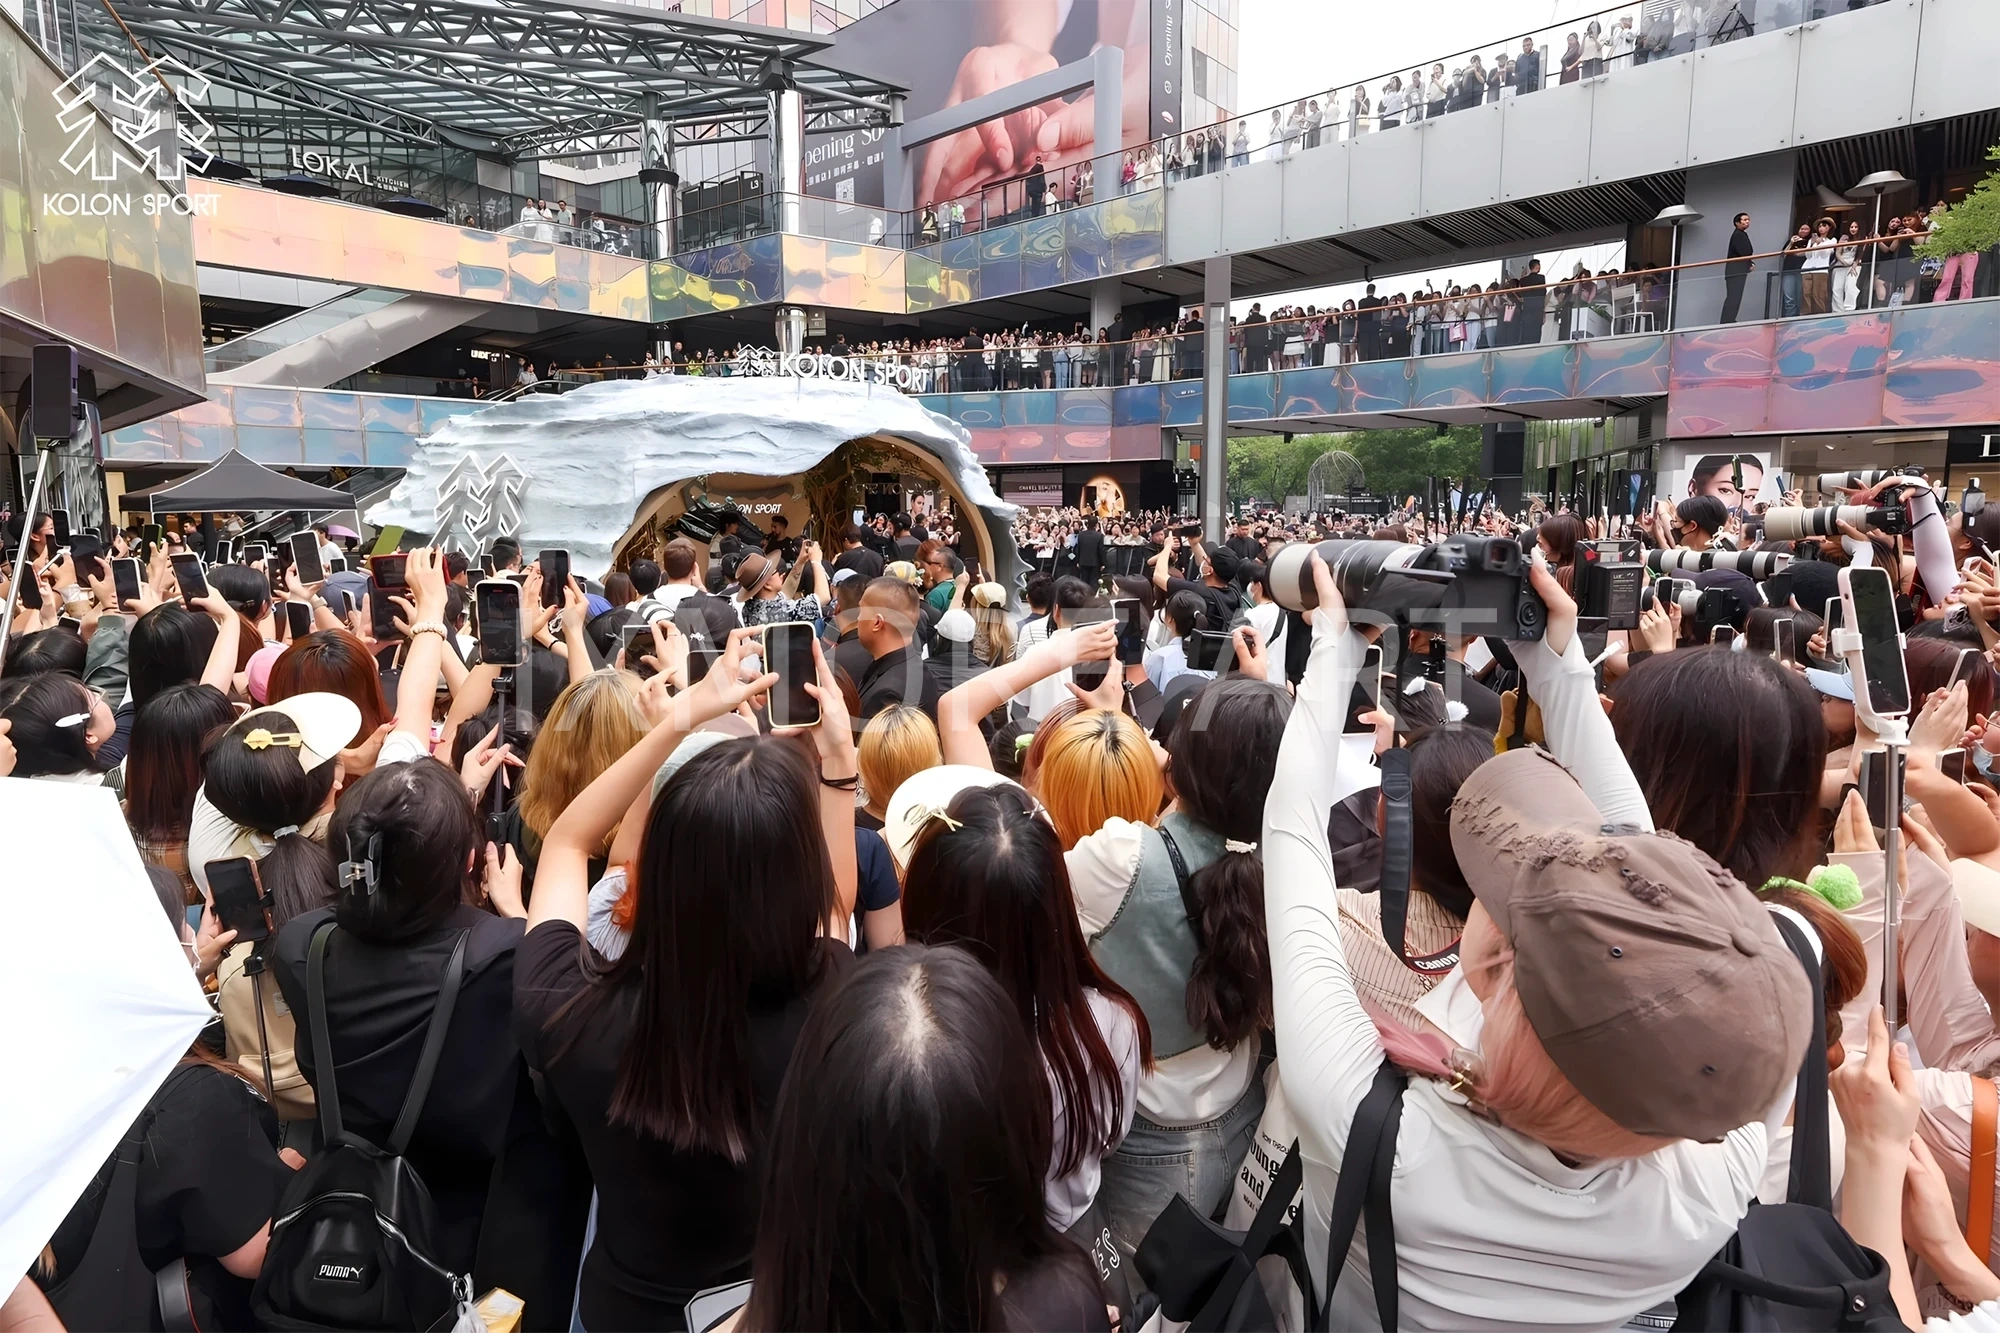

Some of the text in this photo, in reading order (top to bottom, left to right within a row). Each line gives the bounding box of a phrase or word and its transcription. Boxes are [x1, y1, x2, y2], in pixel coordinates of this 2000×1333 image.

[292, 146, 374, 186] LOKAL
[805, 133, 855, 167] pening
[779, 351, 930, 393] KOLON SPORT
[754, 503, 782, 514] SPORT
[1414, 952, 1460, 971] Canon
[1240, 1166, 1265, 1201] and
[319, 1264, 350, 1279] PUMA
